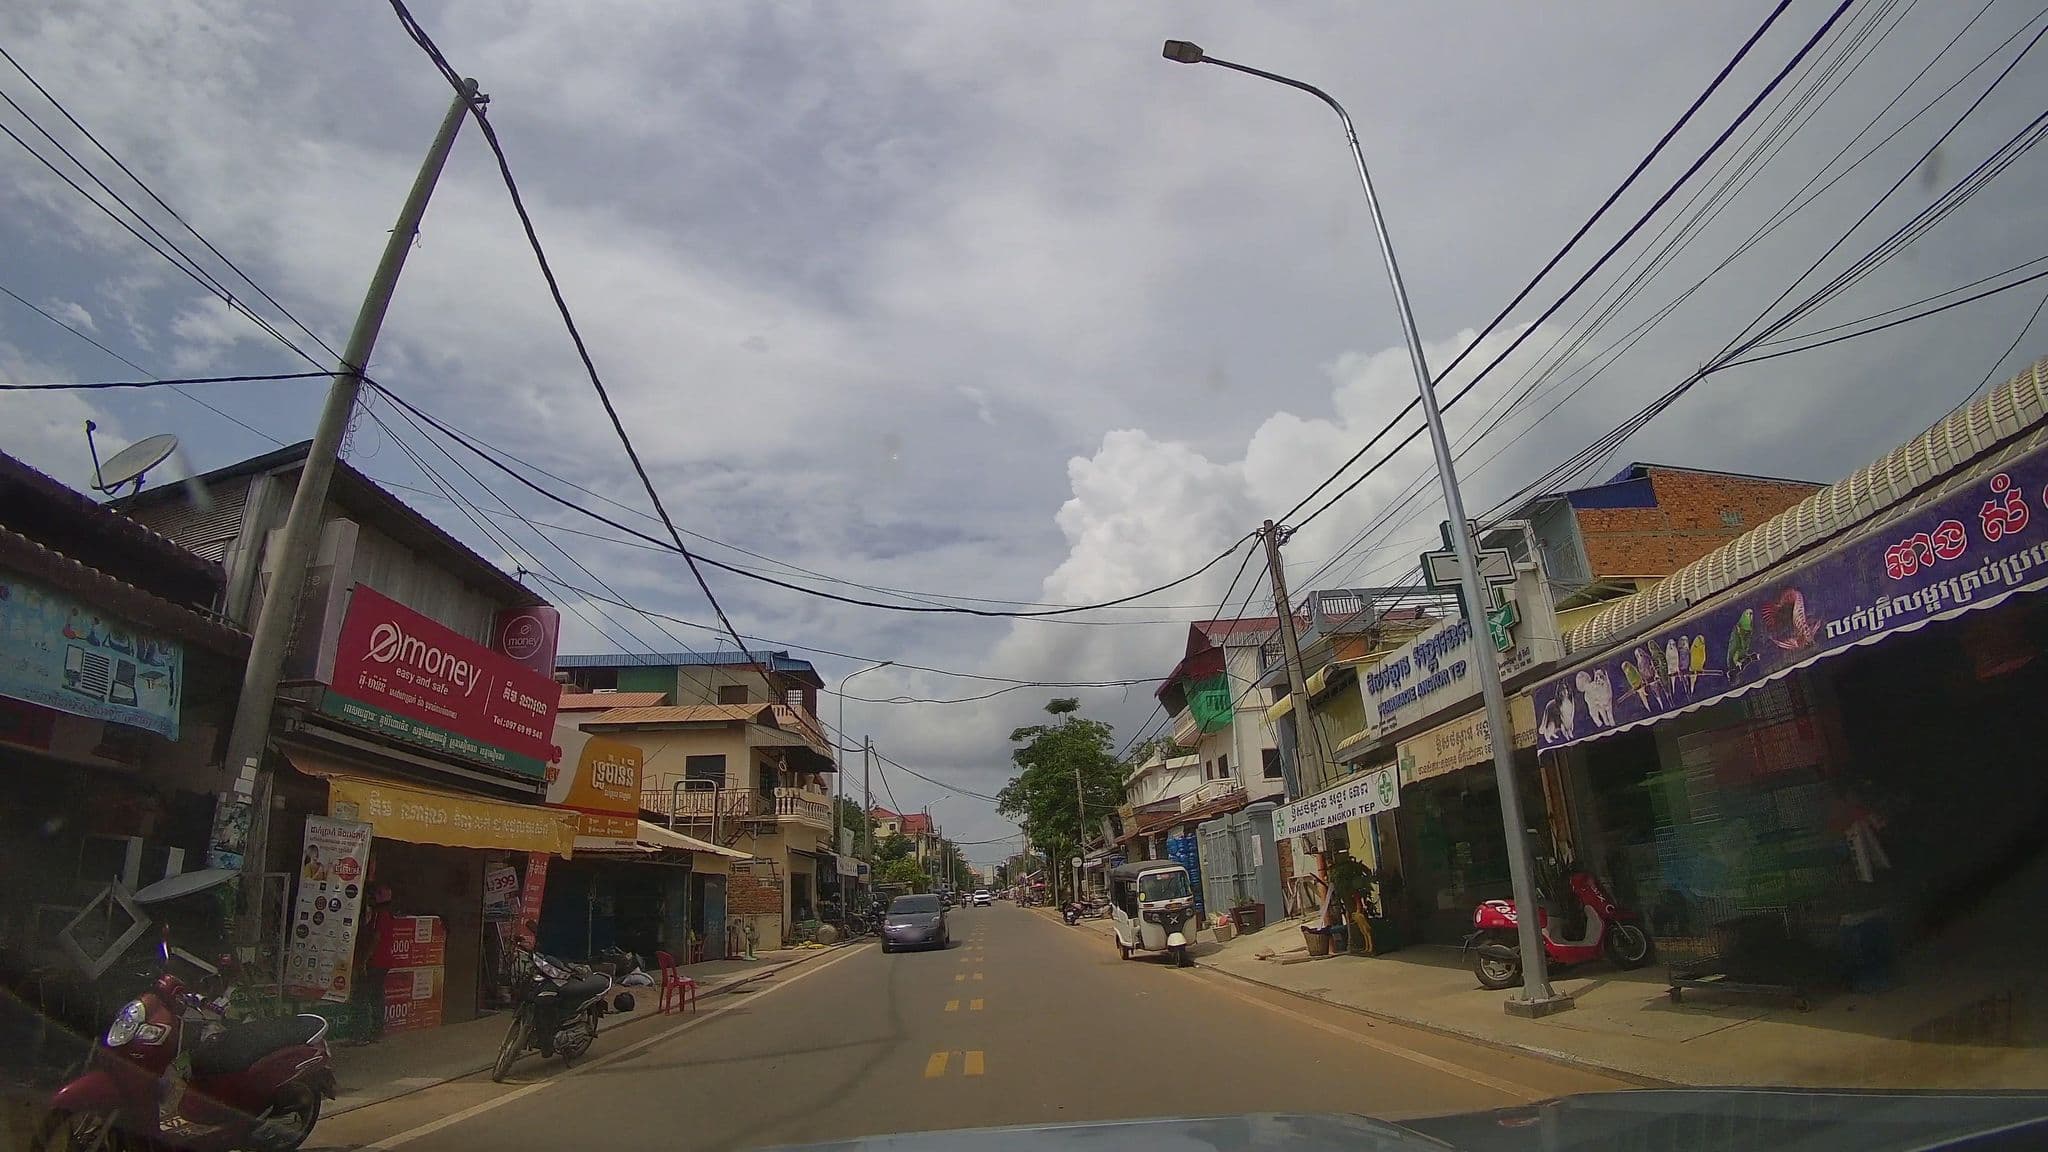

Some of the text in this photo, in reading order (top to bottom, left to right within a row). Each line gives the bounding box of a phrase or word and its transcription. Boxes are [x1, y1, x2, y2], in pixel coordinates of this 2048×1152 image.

[396, 667, 448, 695] easy and safe
[1417, 669, 1450, 698] ANGKOR
[1449, 660, 1467, 682] TEP
[1359, 802, 1376, 814] TEP
